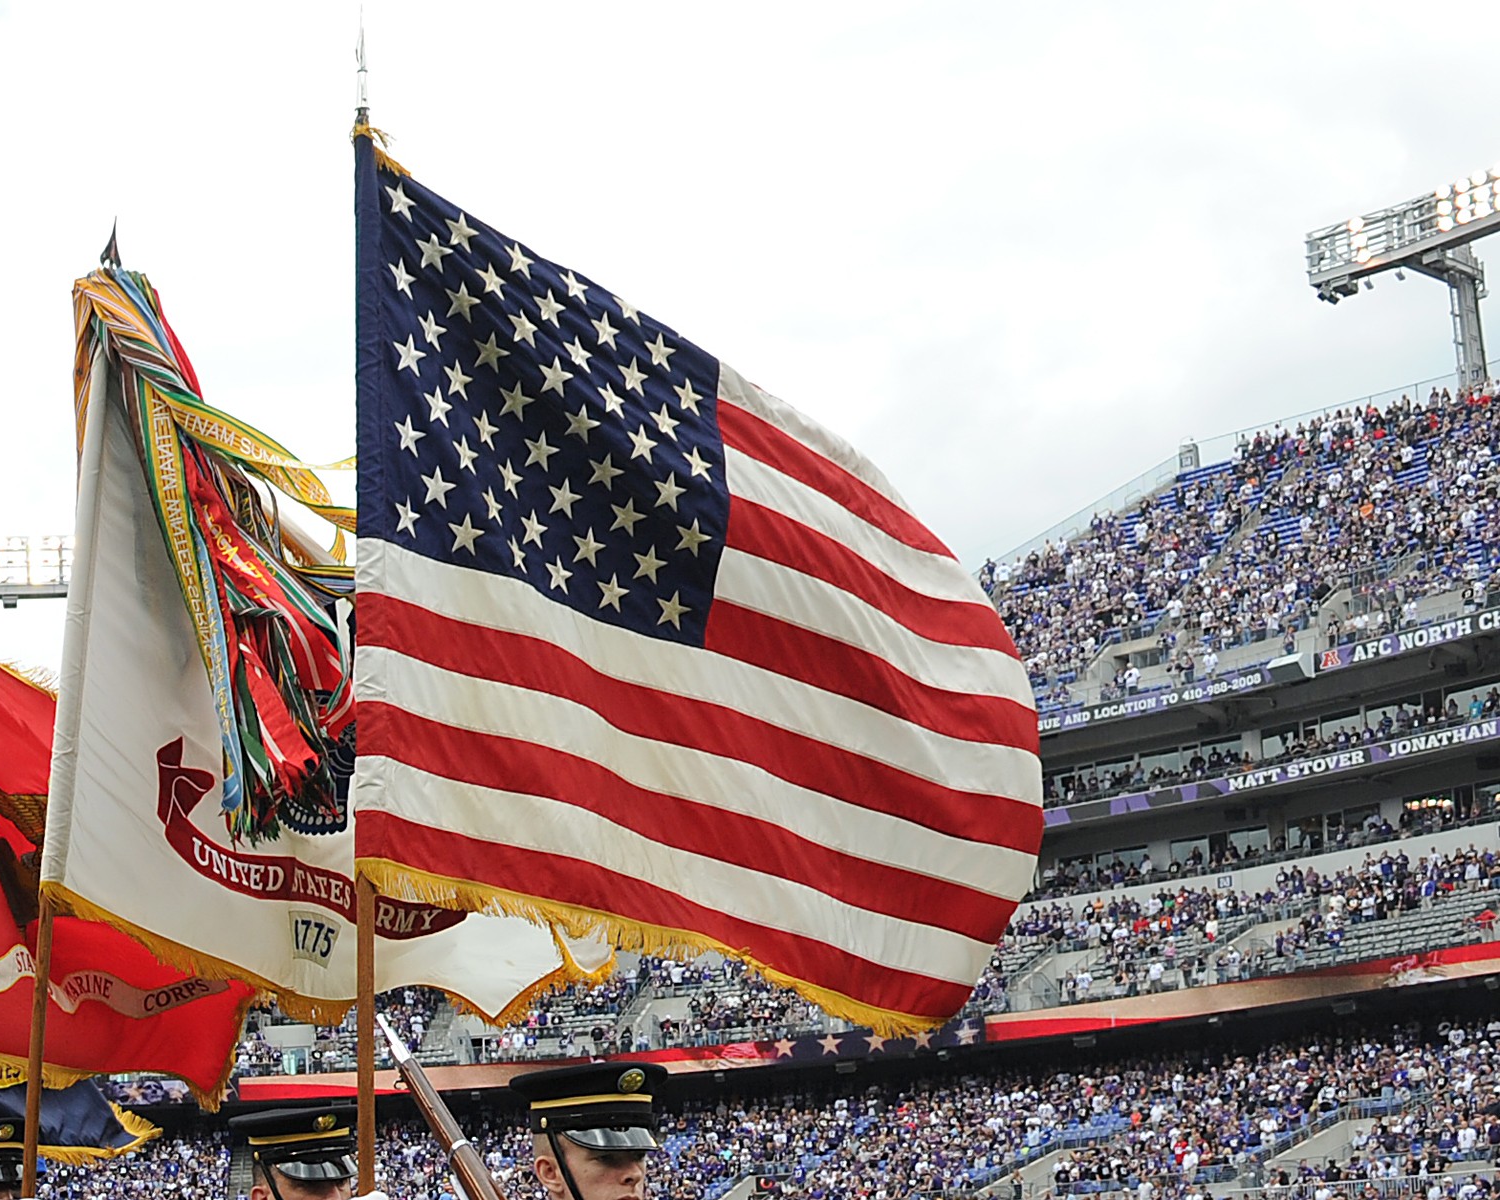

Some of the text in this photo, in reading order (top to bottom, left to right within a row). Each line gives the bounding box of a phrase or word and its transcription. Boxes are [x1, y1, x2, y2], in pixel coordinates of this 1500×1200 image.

[183, 411, 236, 447] TNAM
[1353, 638, 1392, 663] AFC
[1399, 617, 1472, 651] NORTH
[1064, 710, 1091, 726] AND
[1094, 698, 1157, 720] LOCATION
[1160, 692, 1180, 707] TO
[1182, 672, 1262, 701] 410-988-2008
[1228, 720, 1498, 792] MATT STOVER JONATHAN
[191, 836, 285, 892] UNITED
[375, 901, 443, 934] RMY
[294, 919, 336, 959] 1775
[144, 978, 210, 1013] CORPS
